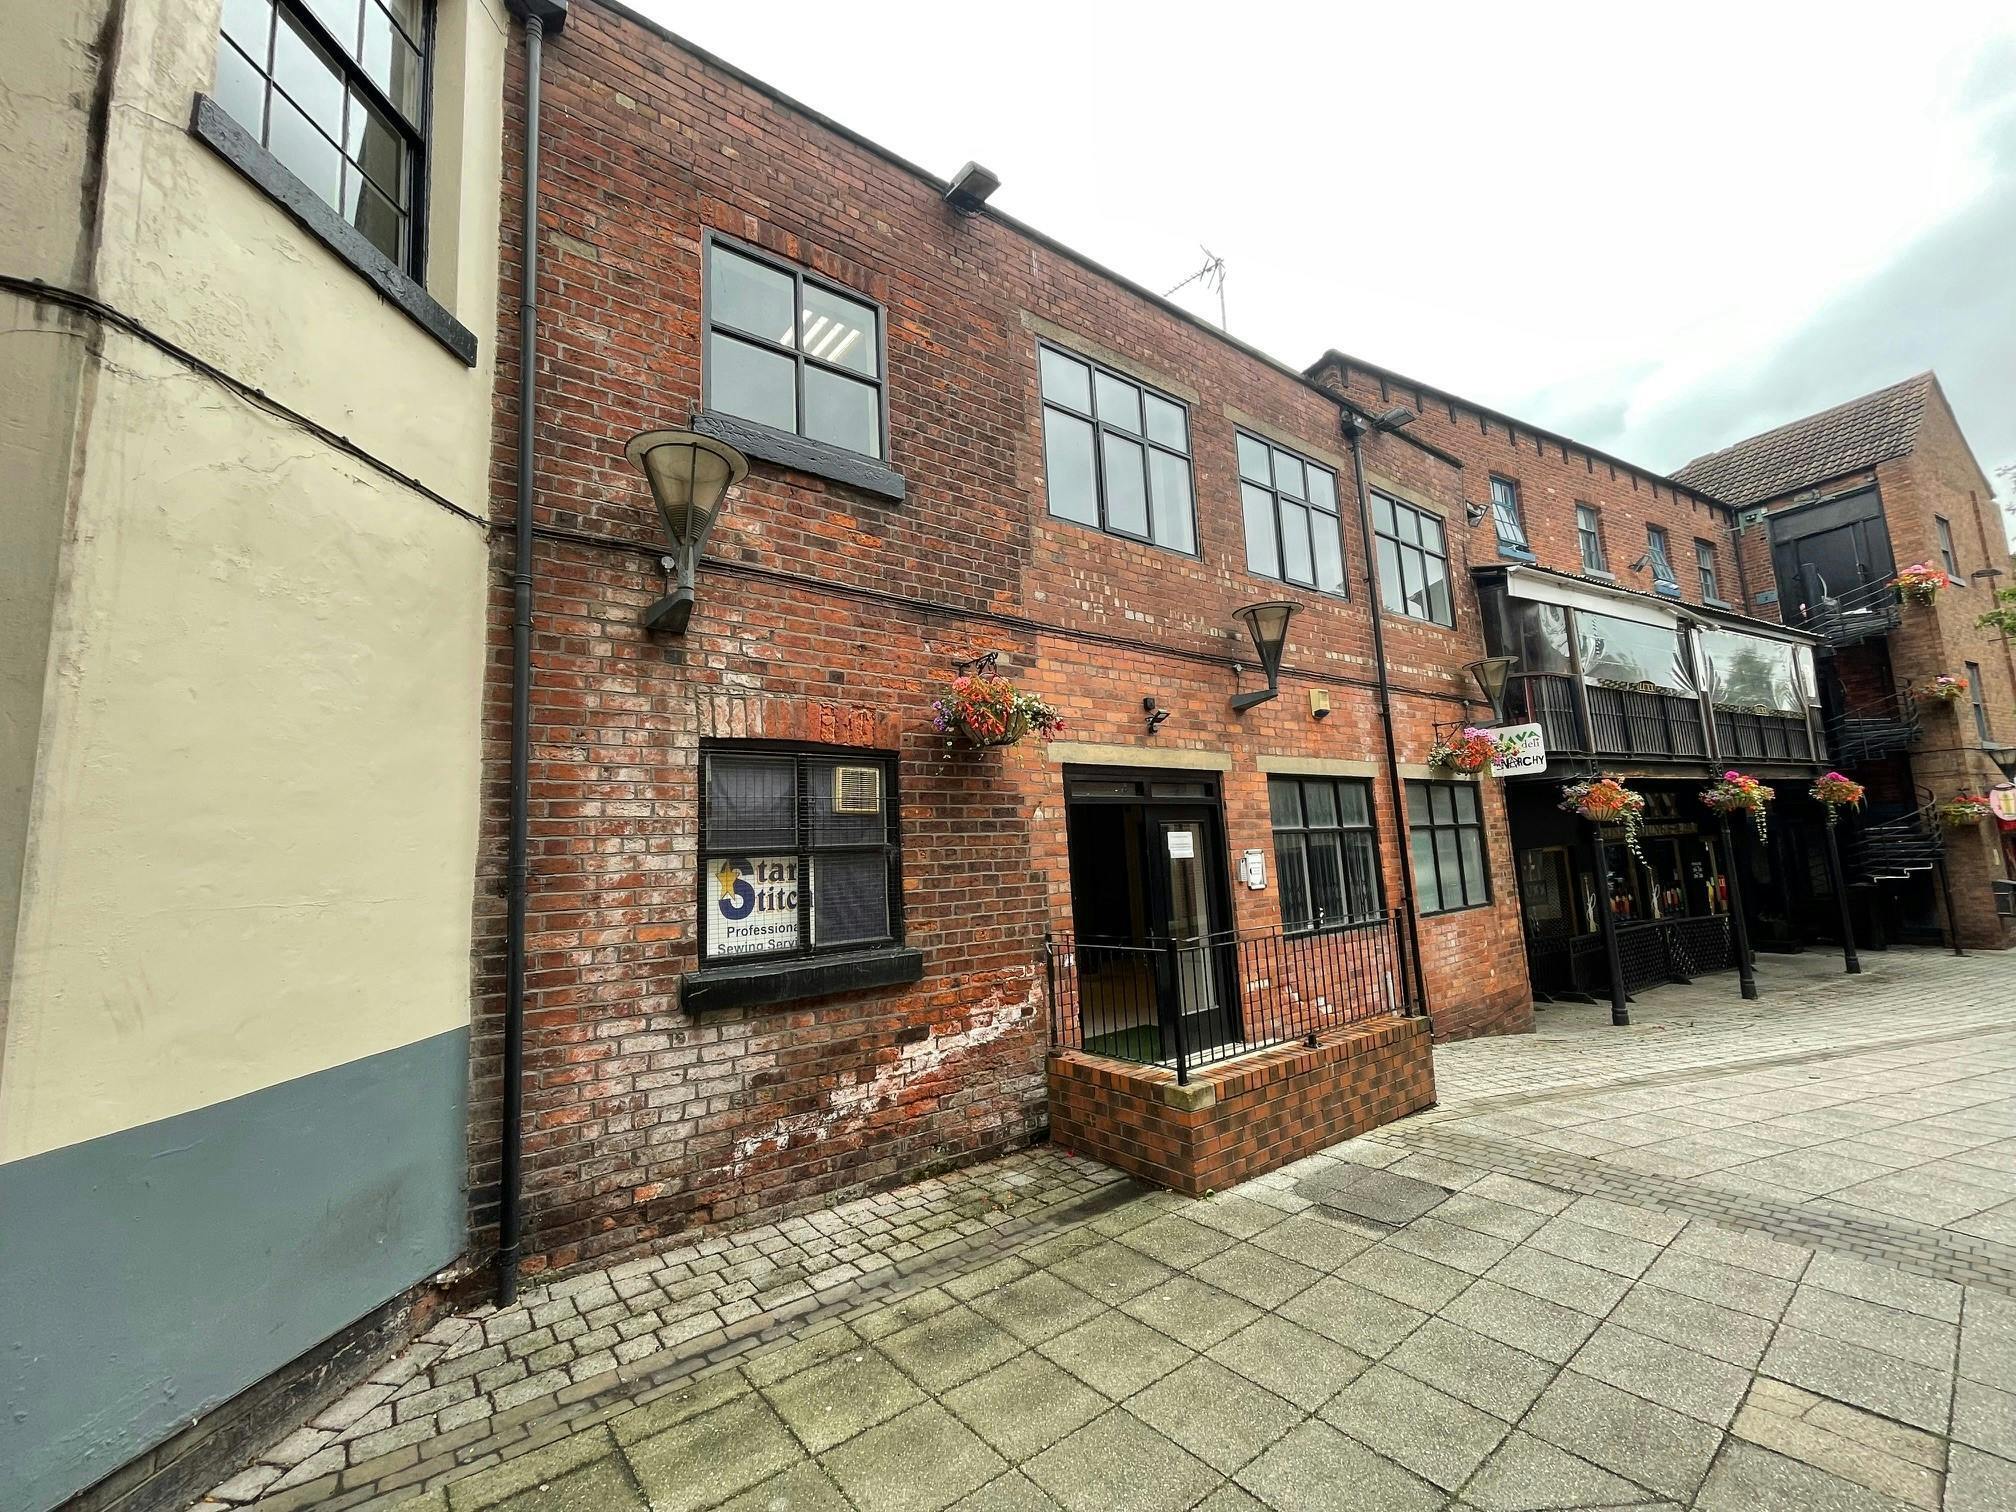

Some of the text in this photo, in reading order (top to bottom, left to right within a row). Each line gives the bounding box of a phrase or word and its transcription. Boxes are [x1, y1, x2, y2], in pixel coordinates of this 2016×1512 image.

[1521, 738, 1540, 748] deli
[1497, 755, 1544, 770] NARCHY
[727, 923, 798, 938] Professiona
